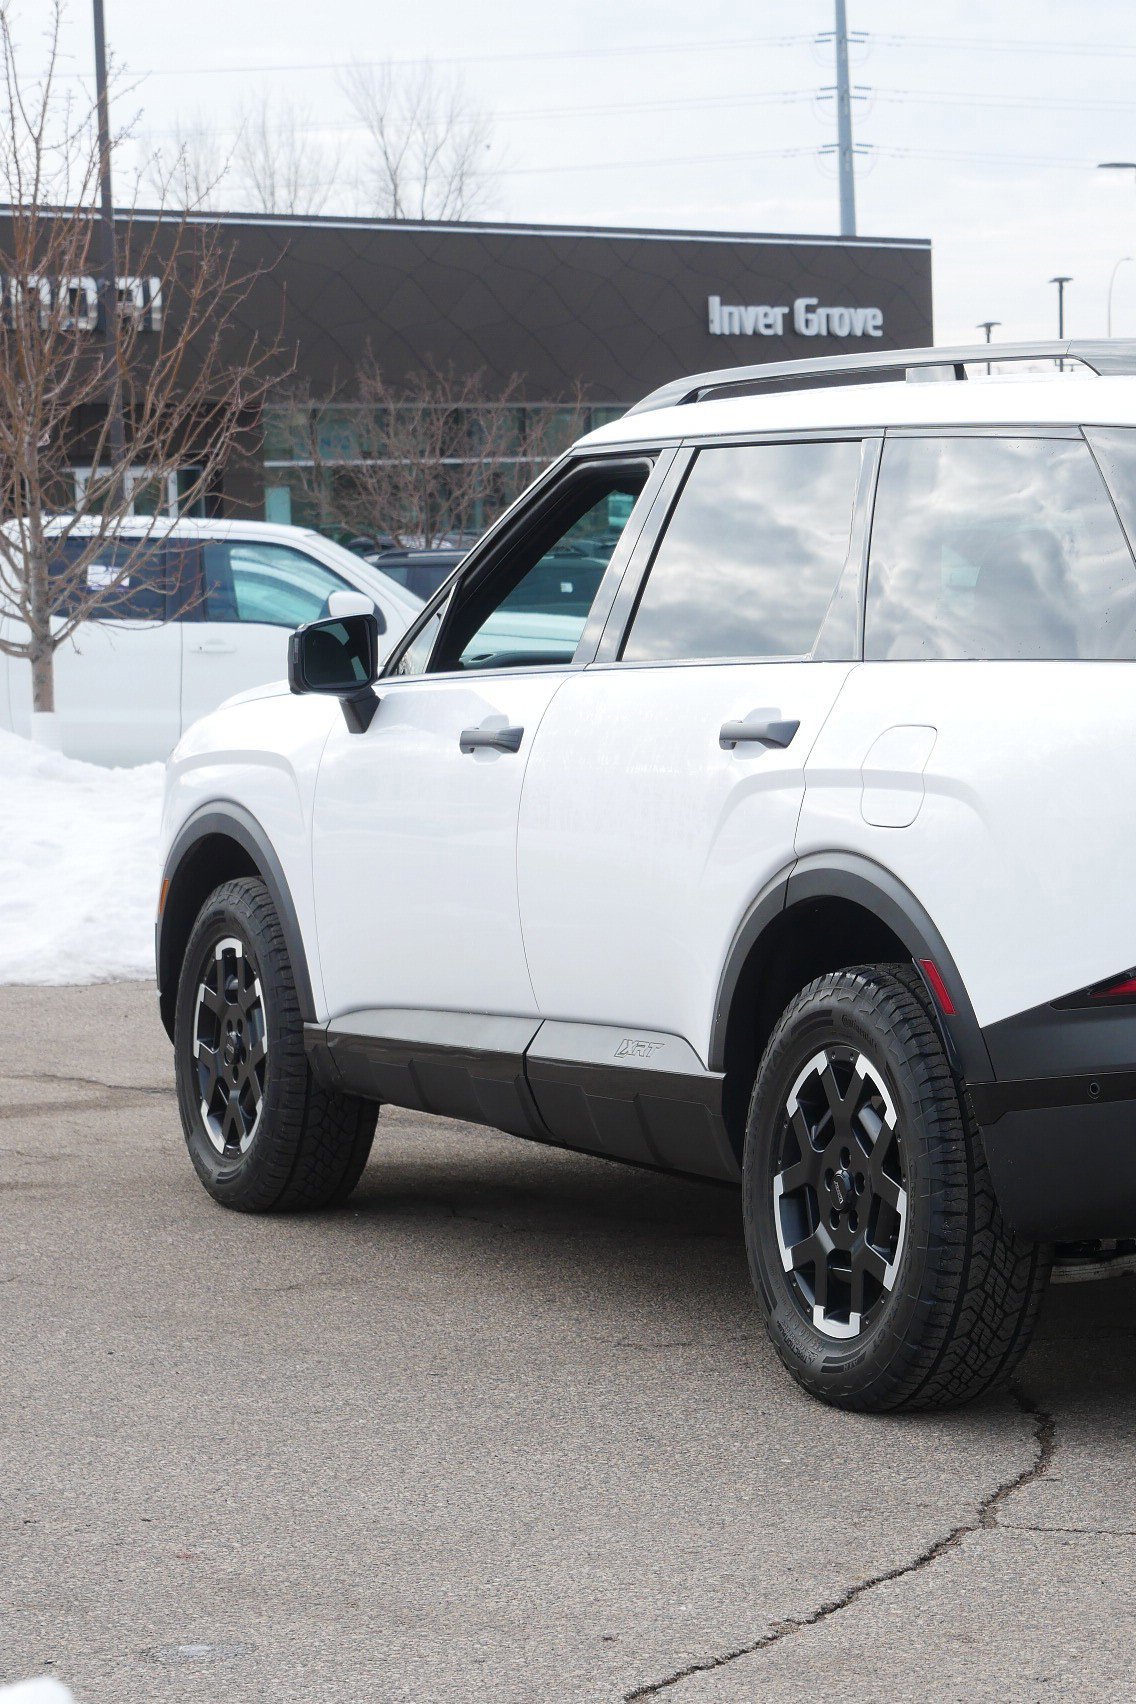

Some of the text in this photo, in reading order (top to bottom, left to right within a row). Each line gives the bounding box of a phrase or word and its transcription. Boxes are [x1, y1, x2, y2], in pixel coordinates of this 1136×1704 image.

[708, 295, 883, 337] Inver Grove
[614, 1038, 665, 1058] XRT
